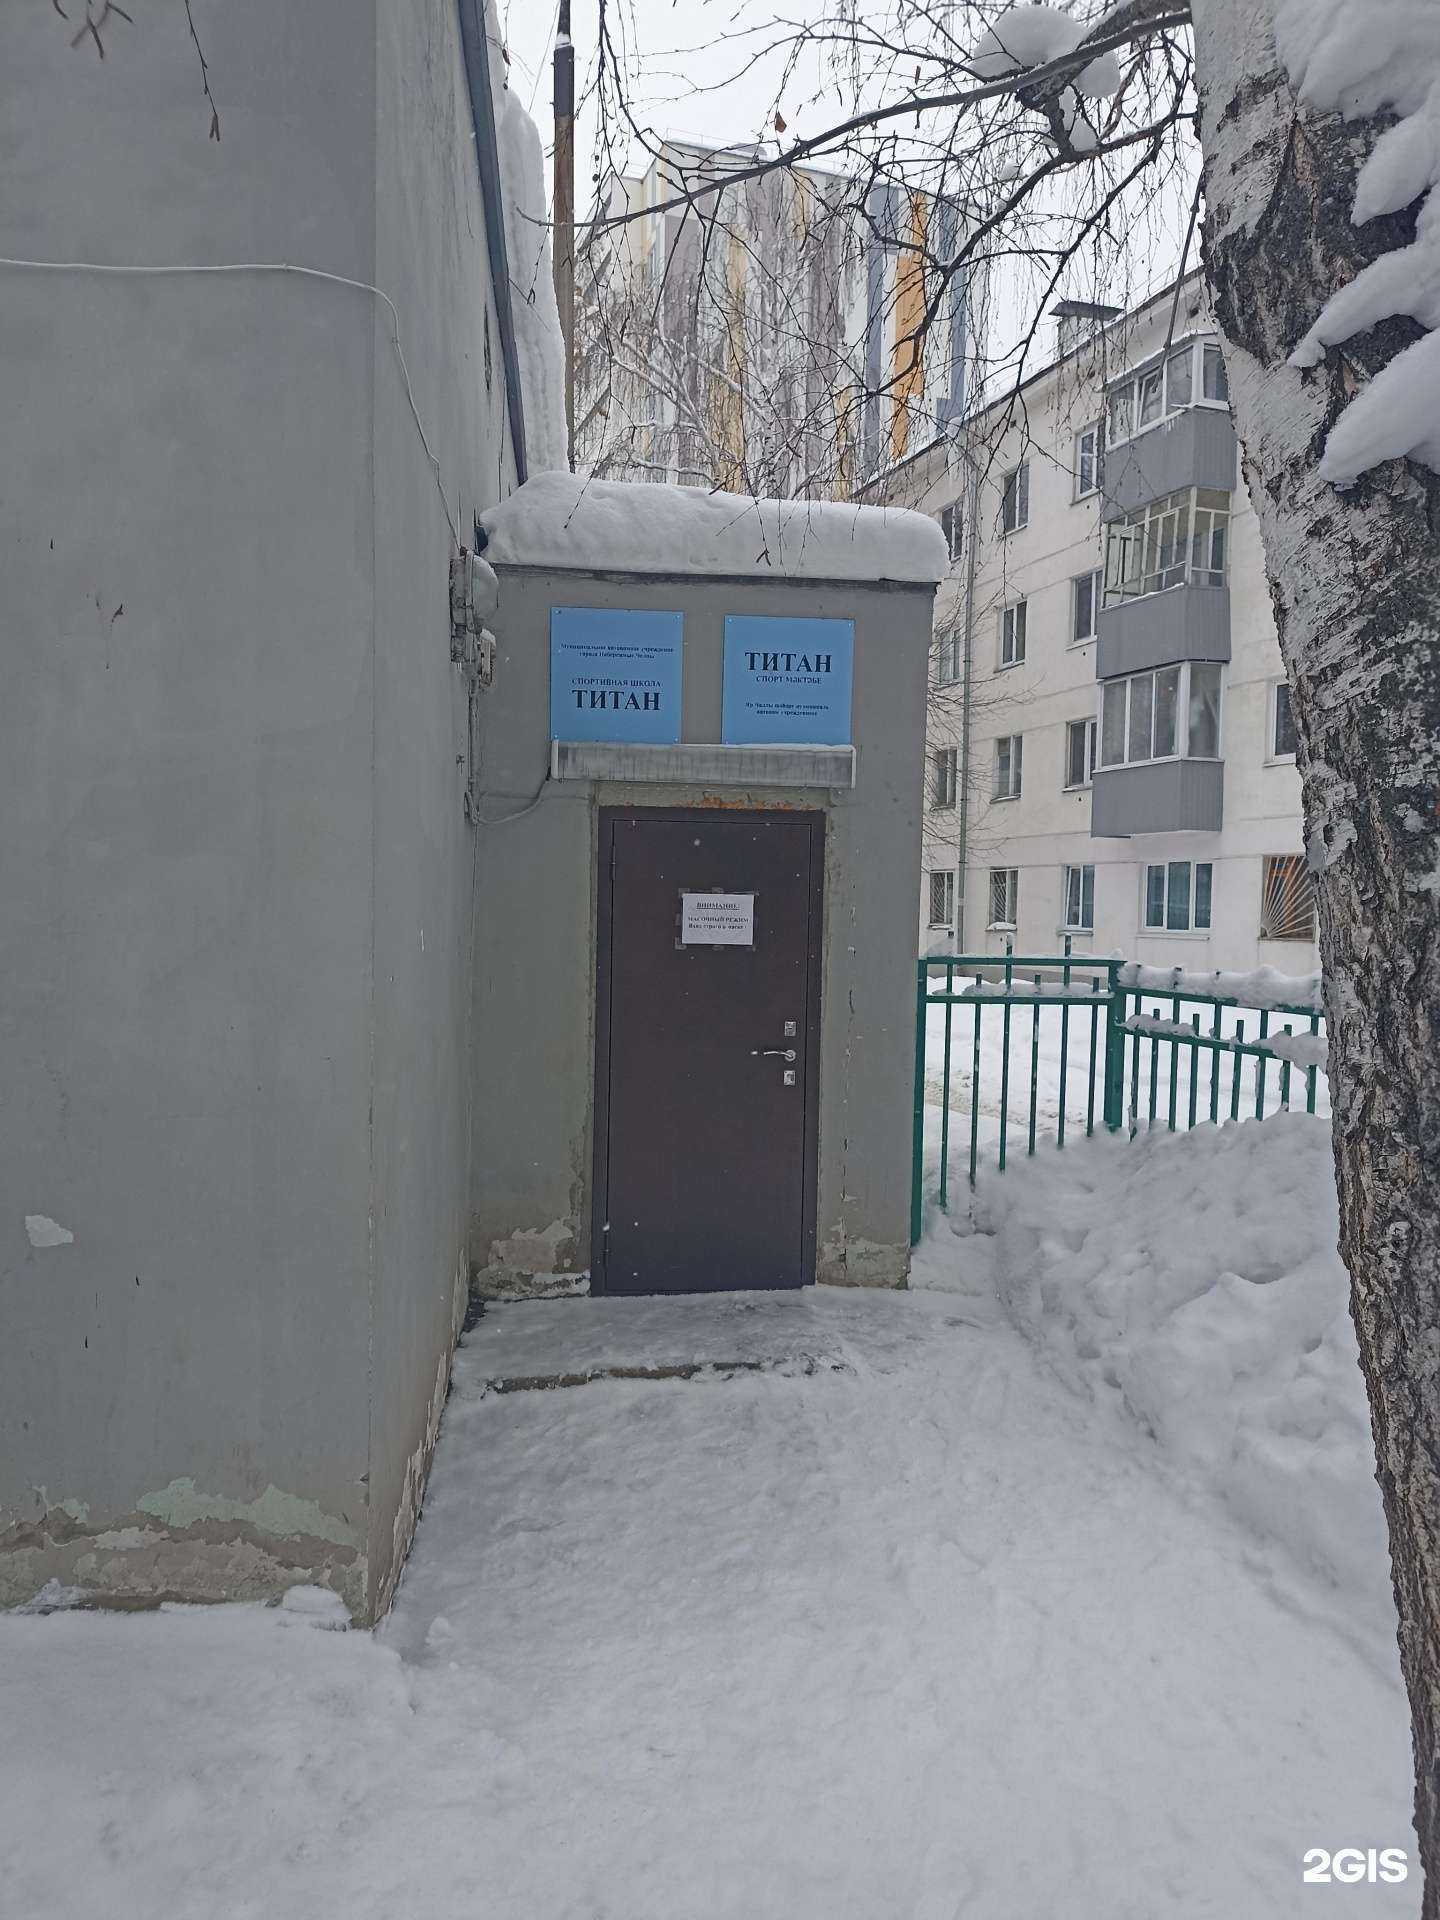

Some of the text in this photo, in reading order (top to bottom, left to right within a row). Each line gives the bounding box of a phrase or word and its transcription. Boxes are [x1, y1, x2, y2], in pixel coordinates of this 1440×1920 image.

[745, 652, 832, 673] ТИТАН
[571, 677, 661, 688] СПОРТИВНАЯ ШКОЛА
[756, 675, 783, 684] СПОРТ
[571, 689, 660, 711] ТИТАН
